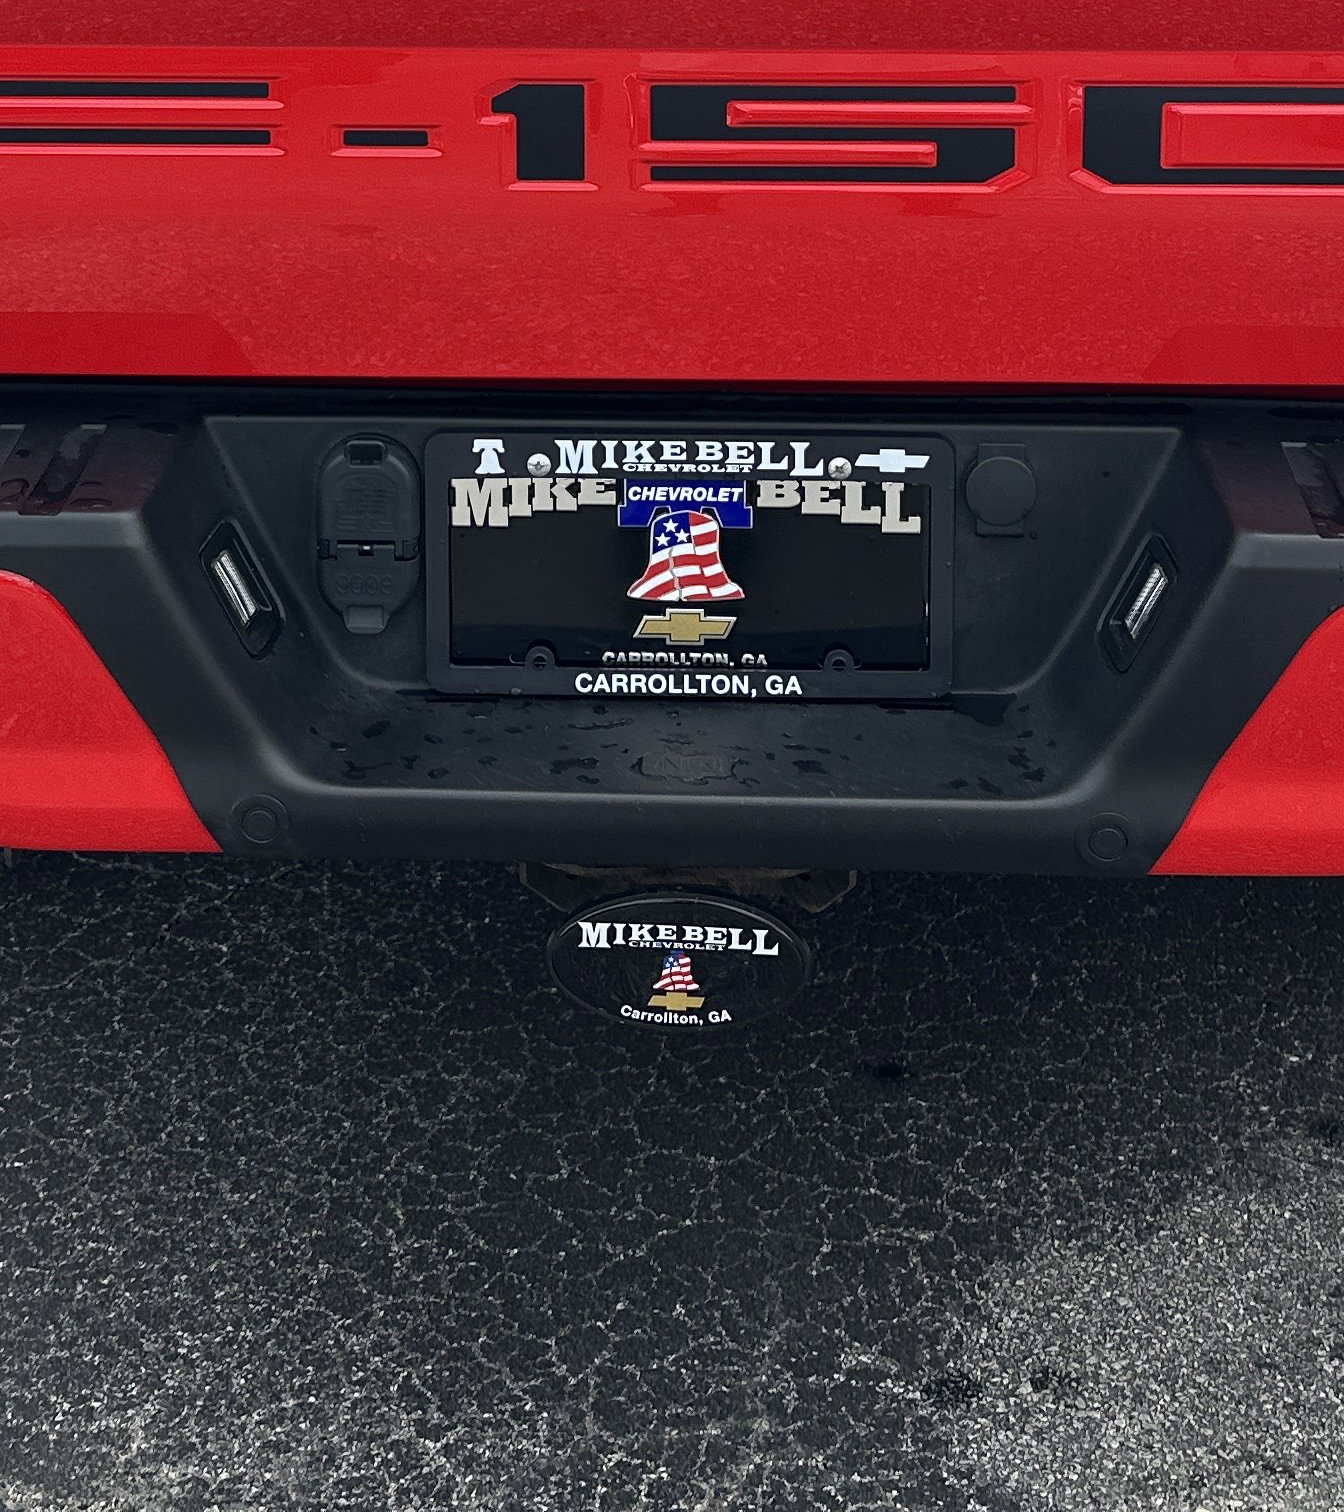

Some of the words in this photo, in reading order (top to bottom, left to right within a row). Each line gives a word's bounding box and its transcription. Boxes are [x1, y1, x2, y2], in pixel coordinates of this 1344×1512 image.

[554, 439, 687, 475] MIKE
[695, 441, 824, 477] BELL
[622, 462, 753, 474] CHEVROLET
[628, 485, 743, 503] CHEVROLET
[451, 478, 617, 527] MIKE
[757, 480, 921, 534] BELL
[741, 653, 768, 667] GA
[575, 672, 757, 698] CARROLLTON,
[765, 674, 802, 695] GA
[577, 921, 677, 948] MIKE
[681, 925, 779, 956] BELL
[628, 940, 725, 951] CHEVROLET
[620, 1004, 704, 1026] Carrollton,
[708, 1009, 732, 1024] GA
